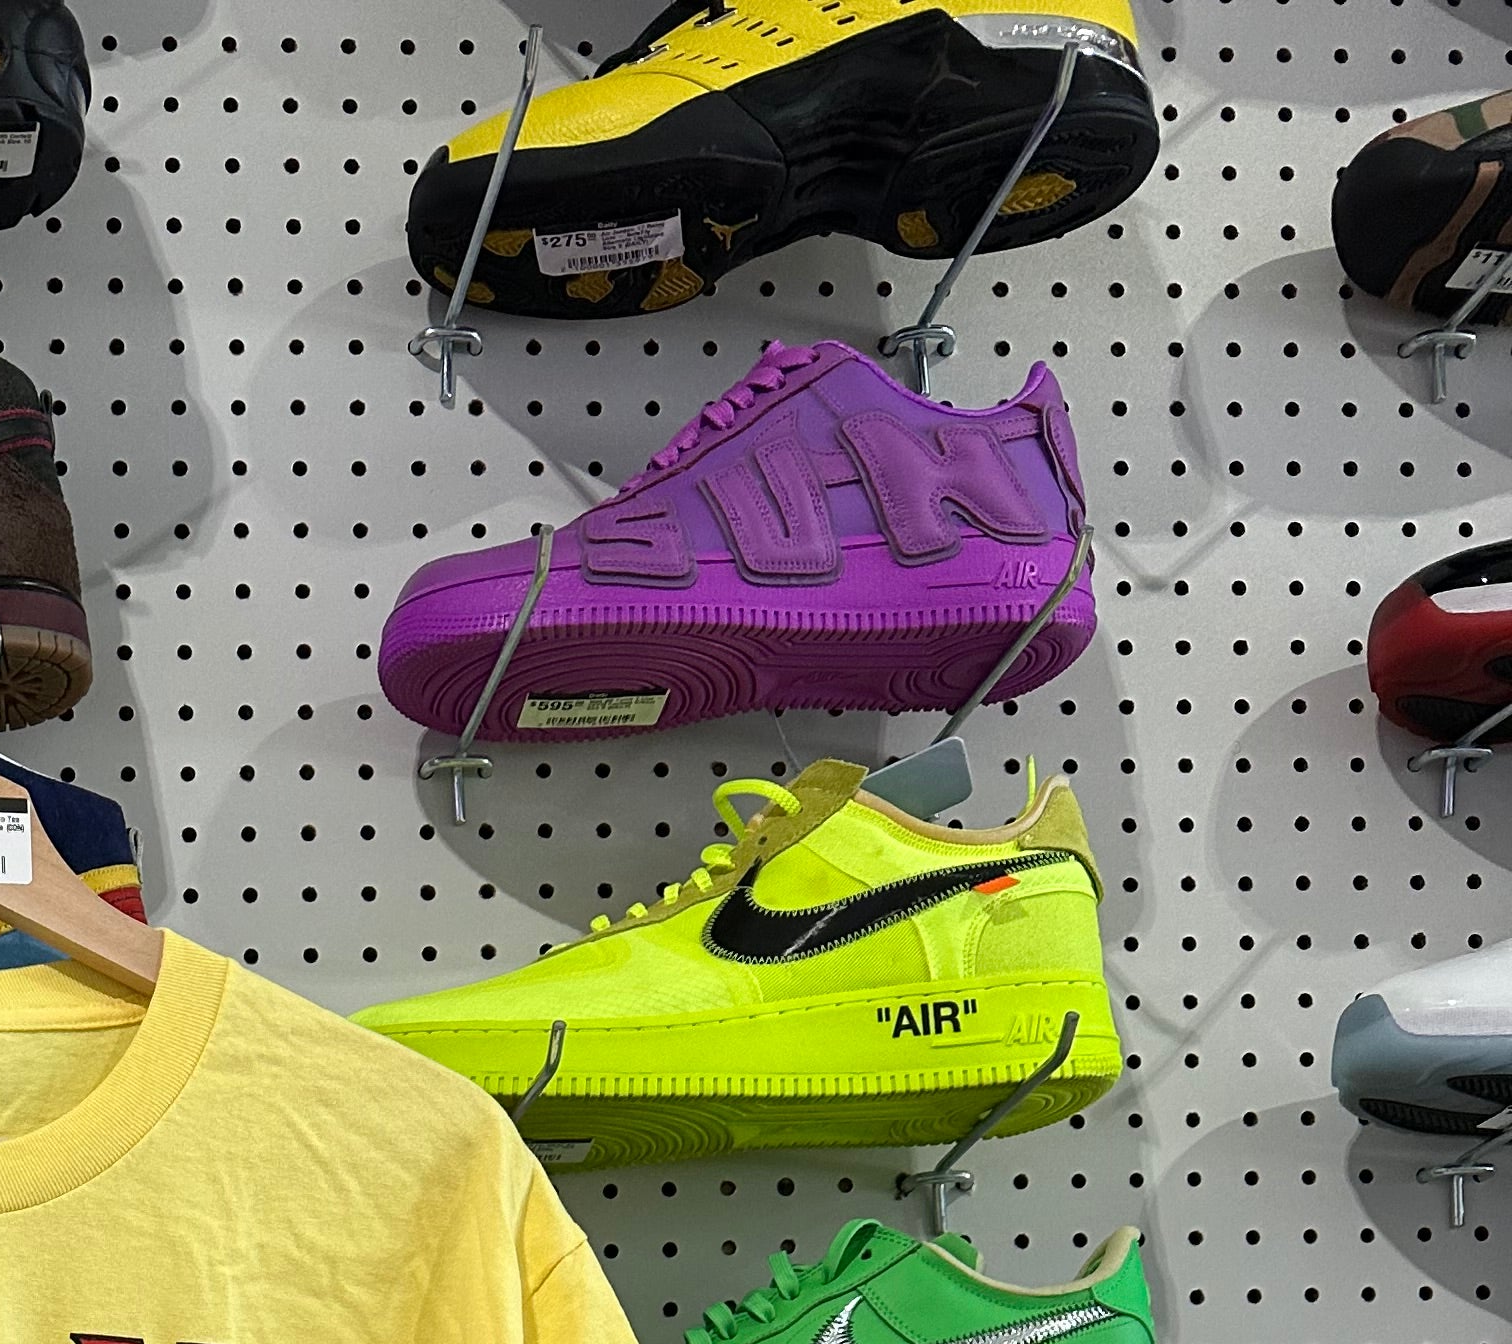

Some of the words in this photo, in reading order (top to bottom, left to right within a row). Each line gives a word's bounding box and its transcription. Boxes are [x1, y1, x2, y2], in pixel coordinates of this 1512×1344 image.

[541, 233, 587, 248] $275
[993, 560, 1040, 591] AIR
[876, 998, 978, 1039] "AIR"
[1004, 1012, 1057, 1047] AIR
